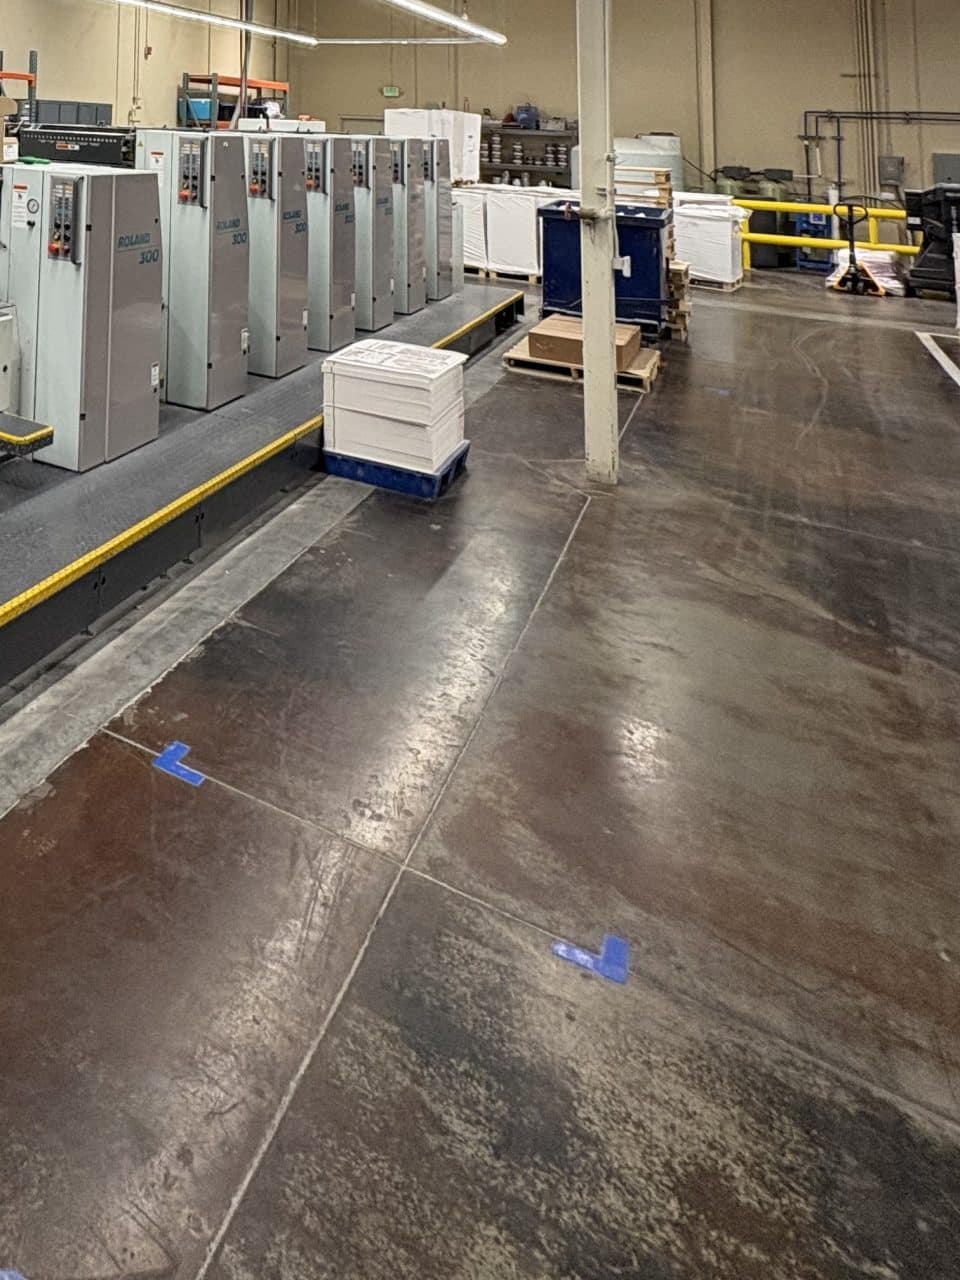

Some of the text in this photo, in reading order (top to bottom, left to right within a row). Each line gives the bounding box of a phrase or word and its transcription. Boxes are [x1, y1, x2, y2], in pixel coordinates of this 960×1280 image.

[118, 232, 150, 248] ROLAND
[231, 231, 247, 245] 300
[138, 249, 159, 264] 300
